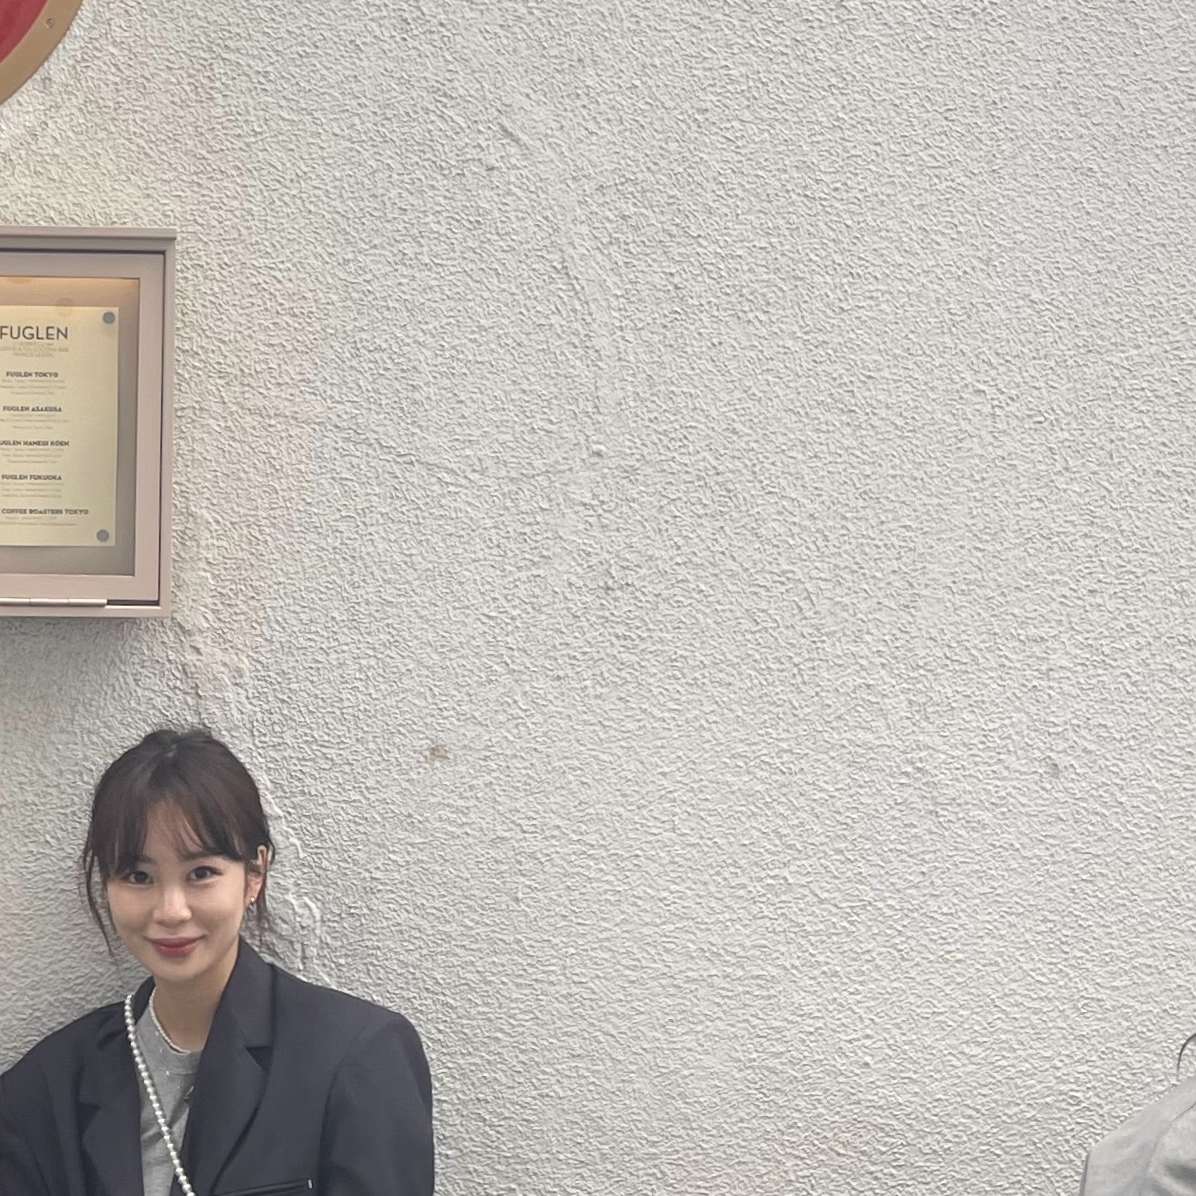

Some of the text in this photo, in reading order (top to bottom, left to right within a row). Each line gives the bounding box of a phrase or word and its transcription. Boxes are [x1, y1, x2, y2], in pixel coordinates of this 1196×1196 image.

[0, 325, 69, 340] FUGLEN
[1, 507, 28, 515] COFFEE
[28, 507, 64, 515] ROASTERS
[64, 507, 90, 515] TOKYO
